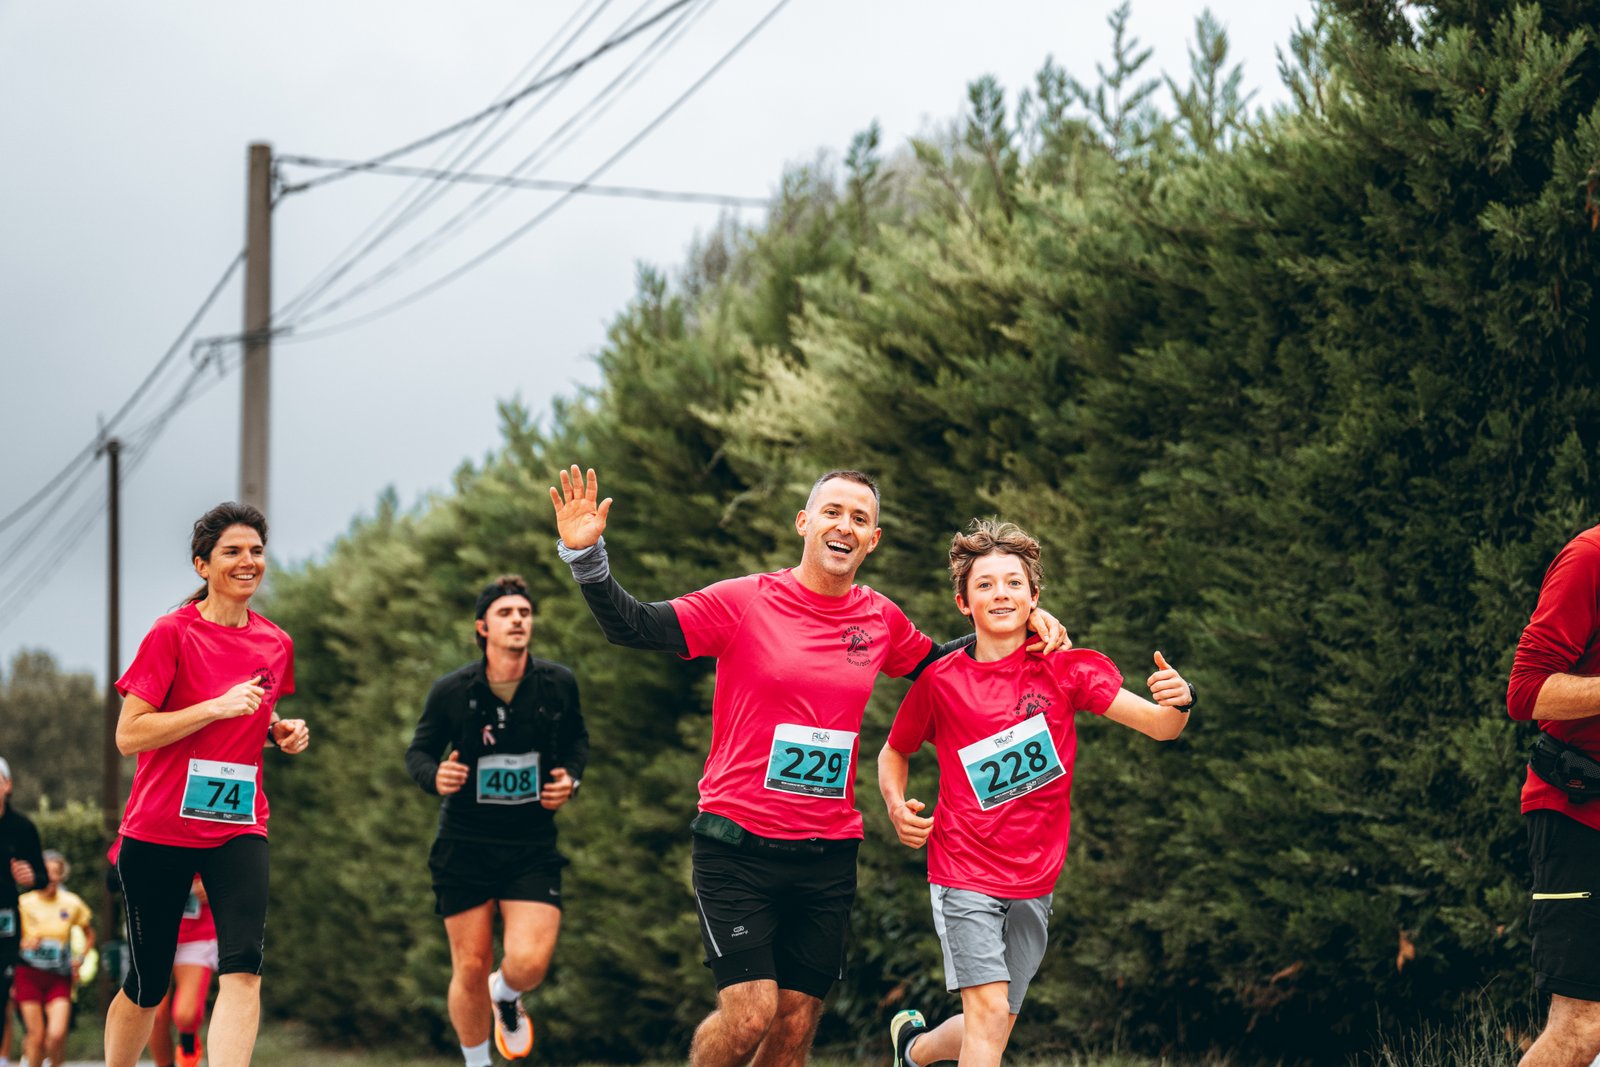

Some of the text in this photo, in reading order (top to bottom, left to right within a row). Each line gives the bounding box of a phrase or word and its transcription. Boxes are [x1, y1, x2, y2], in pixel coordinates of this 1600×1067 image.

[486, 770, 532, 793] 408
[780, 747, 842, 783] 229
[979, 741, 1047, 793] 228
[207, 780, 240, 810] 74
